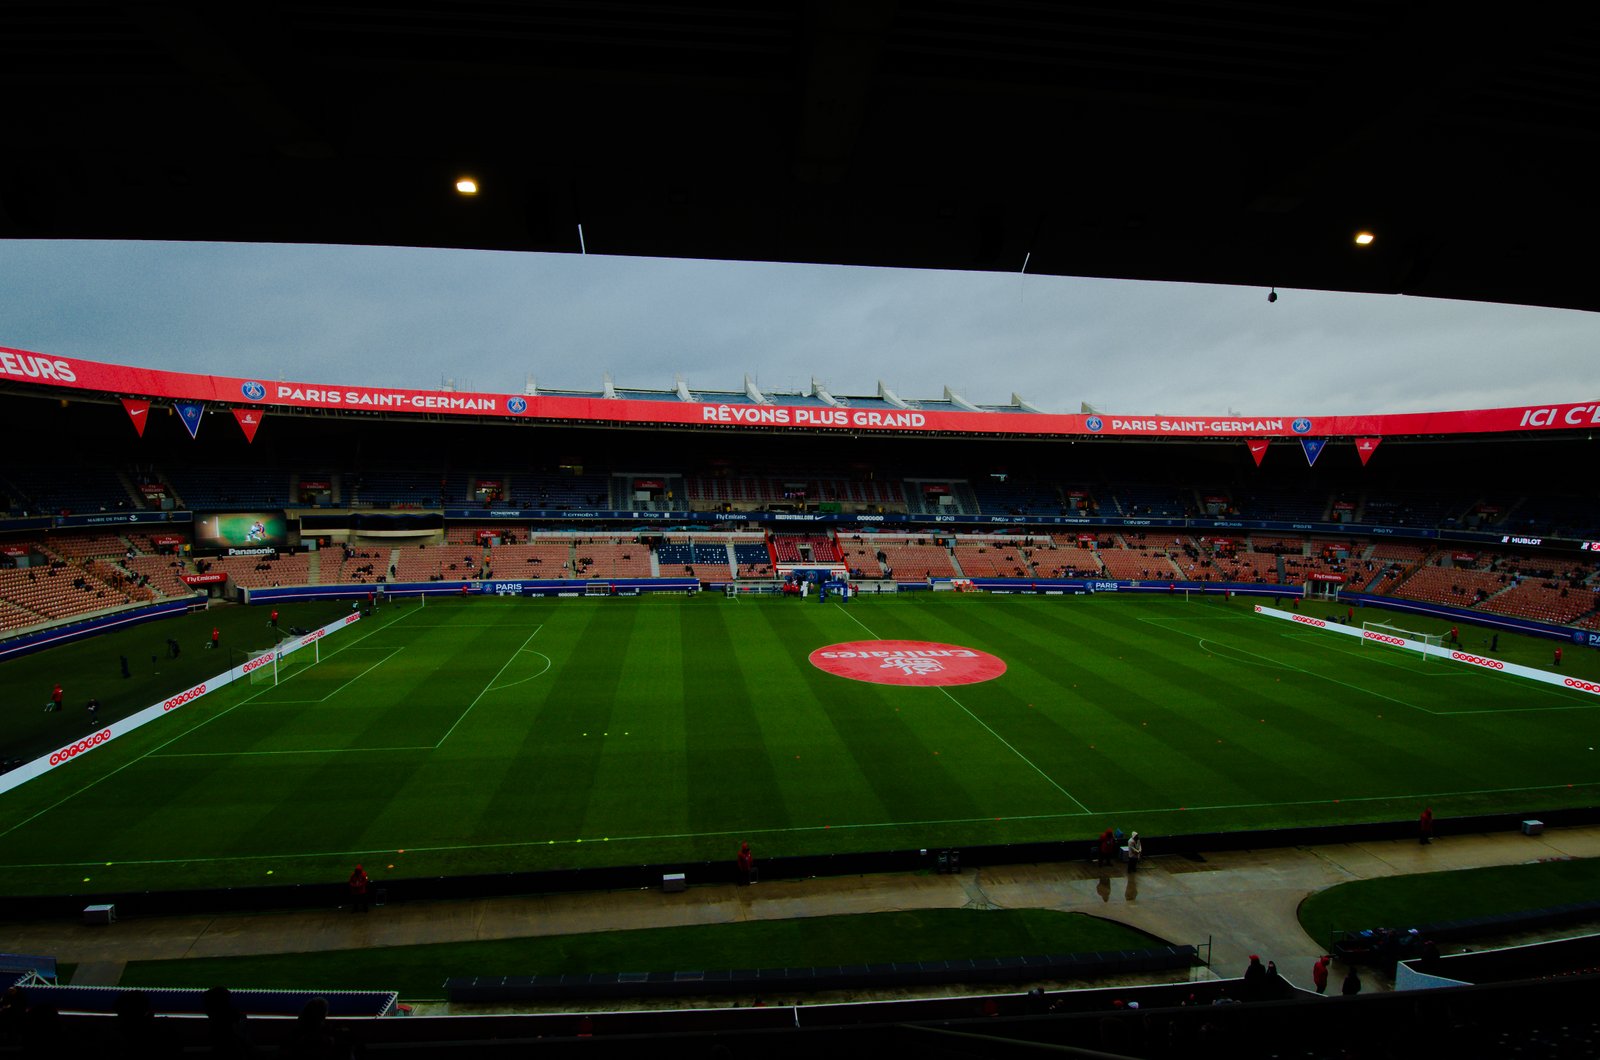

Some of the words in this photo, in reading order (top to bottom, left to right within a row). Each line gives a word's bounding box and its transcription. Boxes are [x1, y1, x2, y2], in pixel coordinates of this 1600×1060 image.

[277, 386, 341, 403] PARIS
[345, 391, 496, 410] SAINT-GERMAIN
[703, 404, 790, 423] RÊVONS
[795, 409, 849, 425] PLUS
[854, 411, 926, 427] GRAND
[1520, 408, 1558, 427] ICI
[1112, 419, 1158, 431] PARIS
[1160, 420, 1283, 432] SAINT-GERMAIN
[1512, 537, 1541, 545] HUBLOT
[228, 547, 276, 555] Panasonic
[495, 583, 522, 591] PARIS
[1364, 631, 1405, 646] ooredoo
[821, 650, 980, 659] Emirates
[1452, 651, 1504, 670] ooredoo
[164, 684, 207, 711] ooredoo
[50, 729, 111, 766] ooredoo
